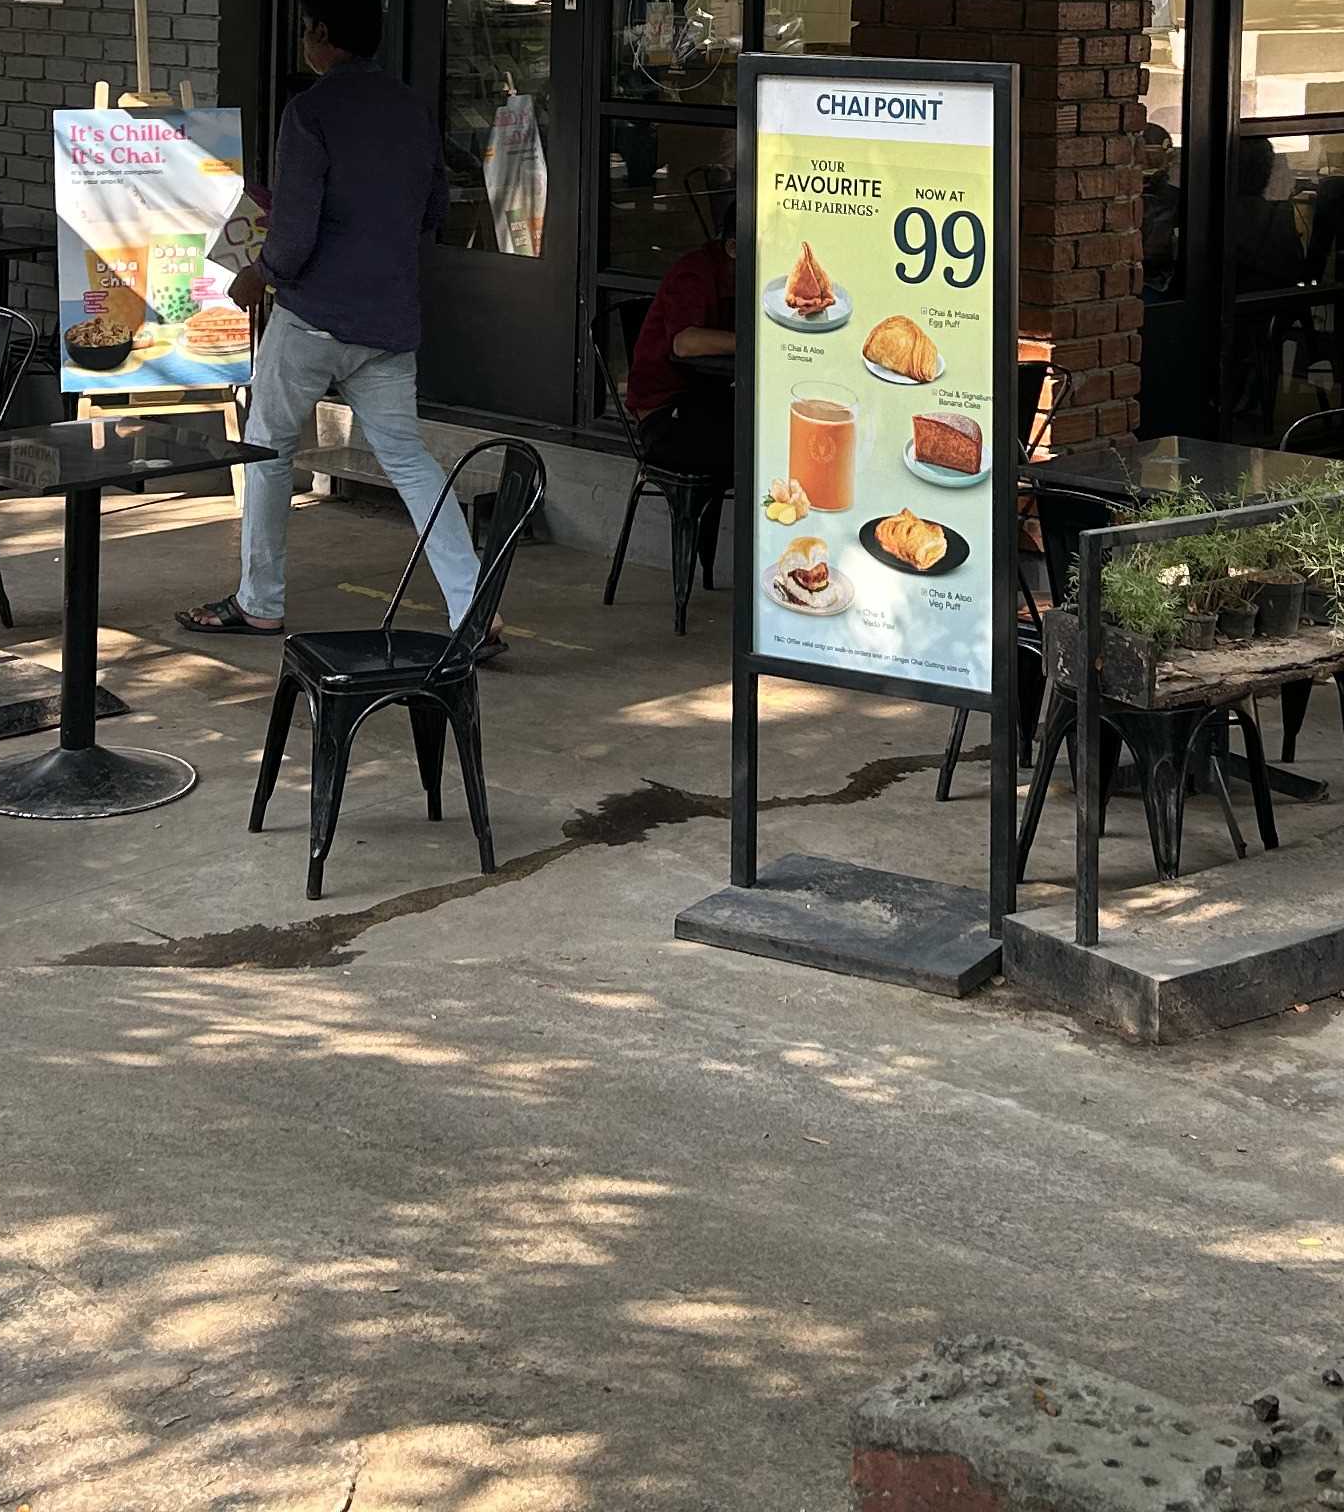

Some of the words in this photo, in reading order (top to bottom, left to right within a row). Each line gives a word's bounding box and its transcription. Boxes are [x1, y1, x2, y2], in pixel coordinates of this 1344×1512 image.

[816, 93, 869, 117] CHAI
[874, 96, 944, 121] POINT
[69, 124, 105, 143] It's
[109, 123, 192, 143] Chilled.
[70, 146, 105, 166] It's
[110, 146, 167, 165] Chai.
[810, 159, 846, 173] YOUR
[774, 173, 883, 199] FAVOURITE
[914, 187, 947, 202] NOW
[948, 190, 966, 203] AT
[782, 198, 812, 212] CHAI
[814, 201, 874, 217] PAIRINGS
[893, 206, 986, 289] 99
